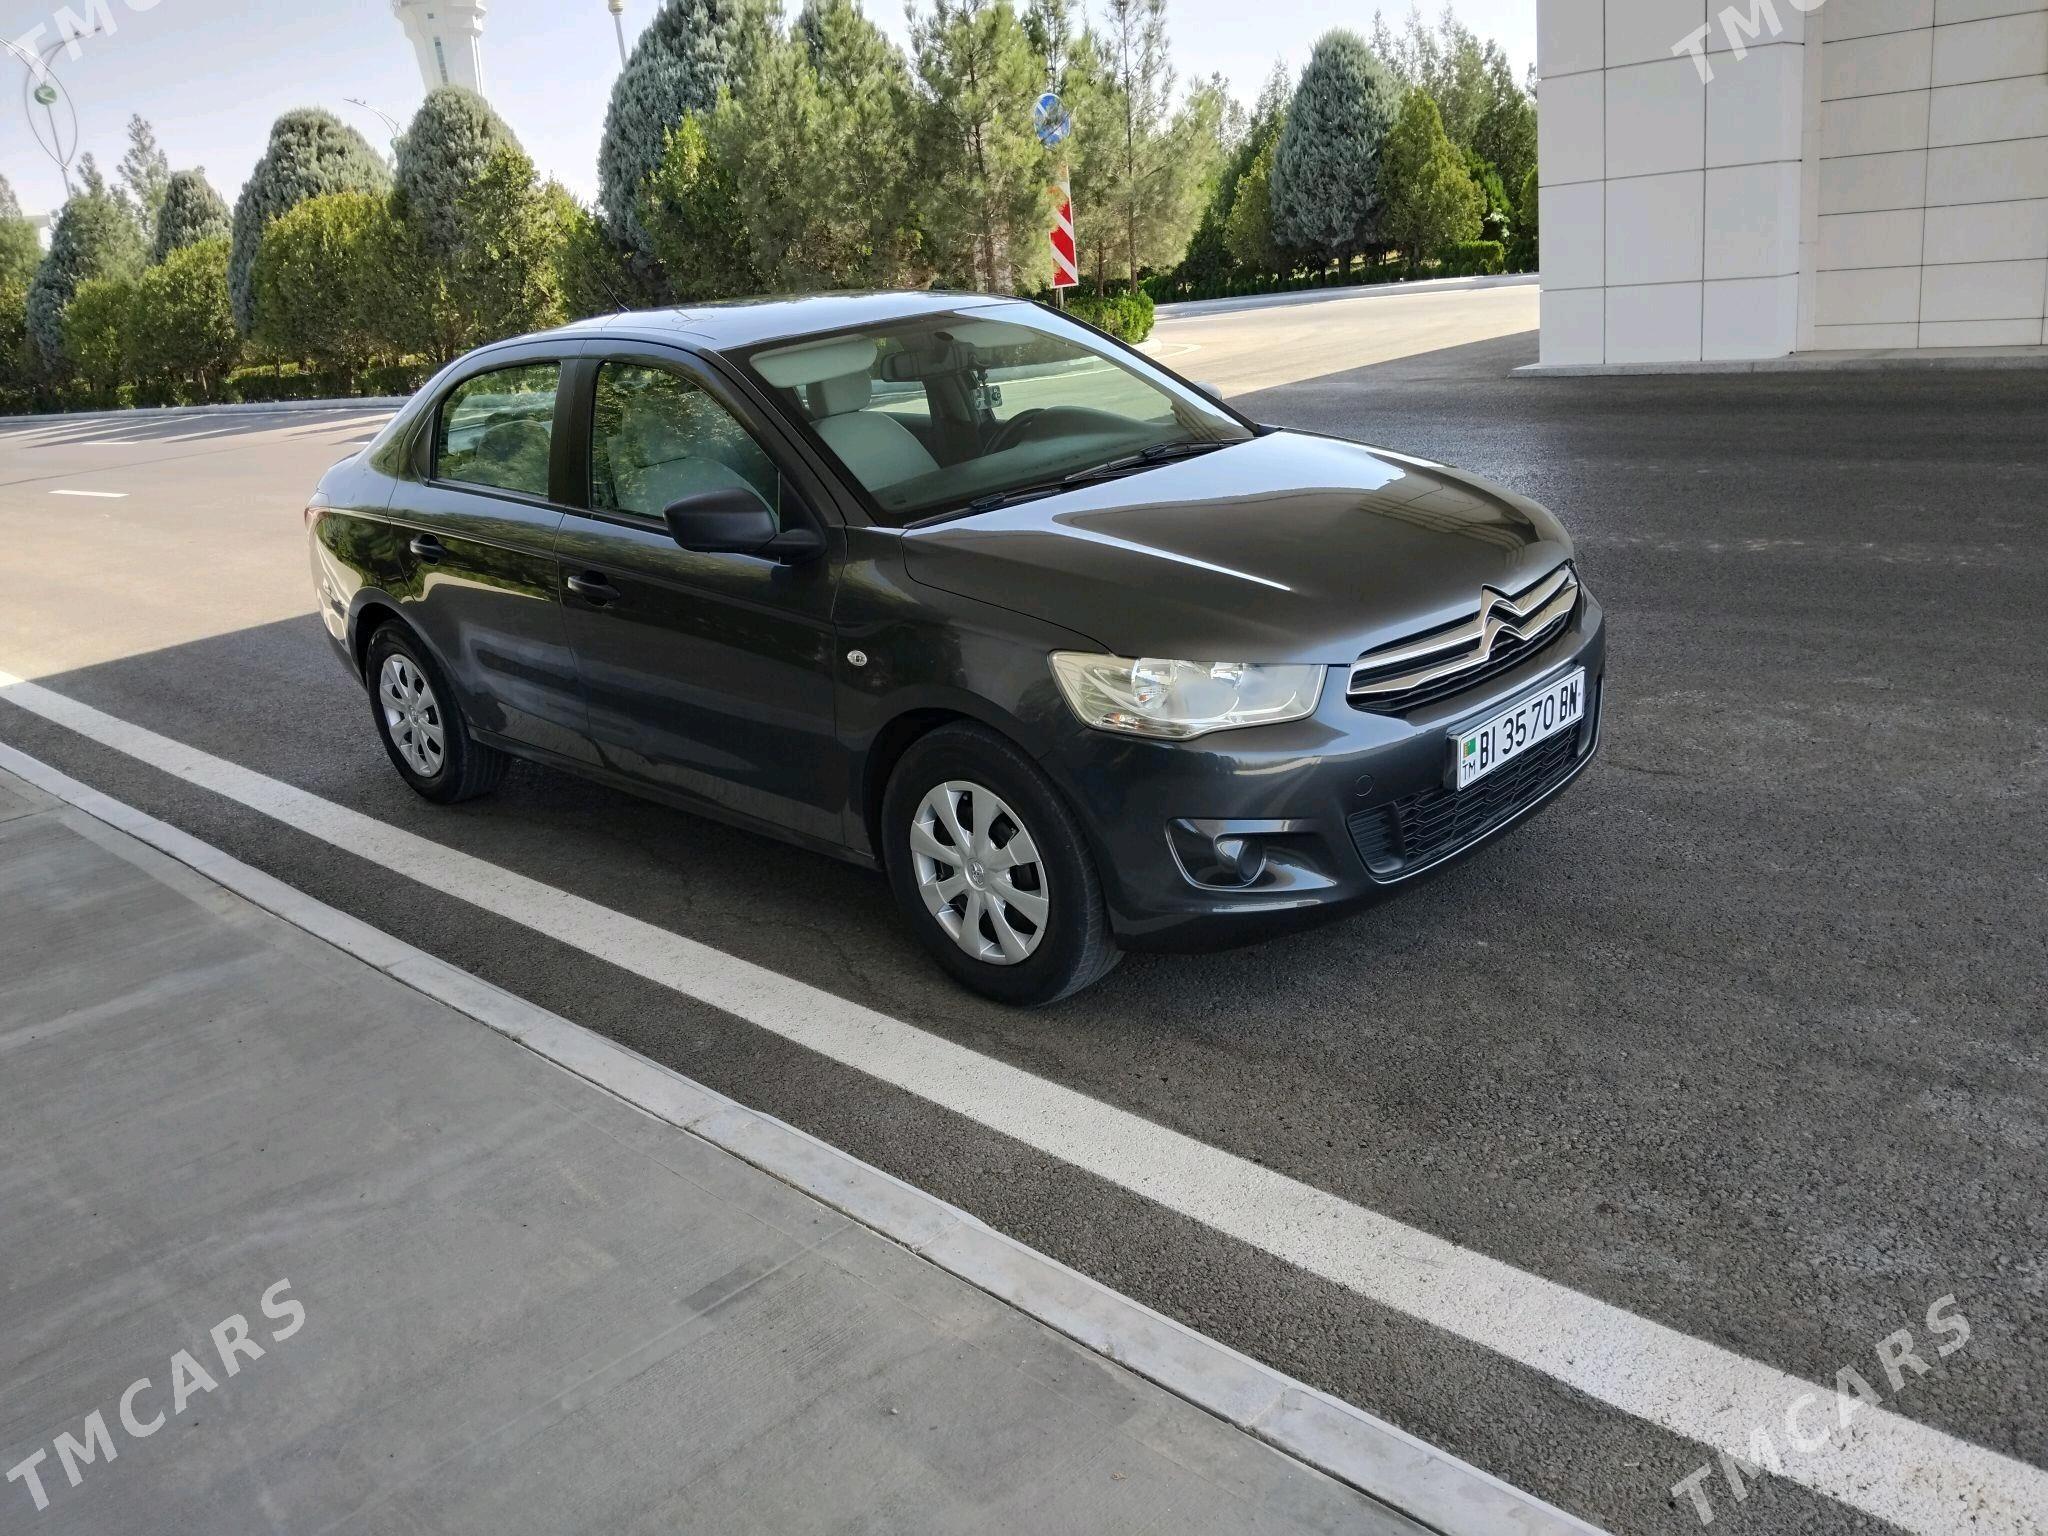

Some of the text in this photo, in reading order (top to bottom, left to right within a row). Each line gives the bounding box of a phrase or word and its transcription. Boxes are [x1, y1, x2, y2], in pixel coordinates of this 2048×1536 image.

[1502, 694, 1555, 755] 3570
[1559, 679, 1578, 723] BN
[1462, 759, 1476, 780] TM
